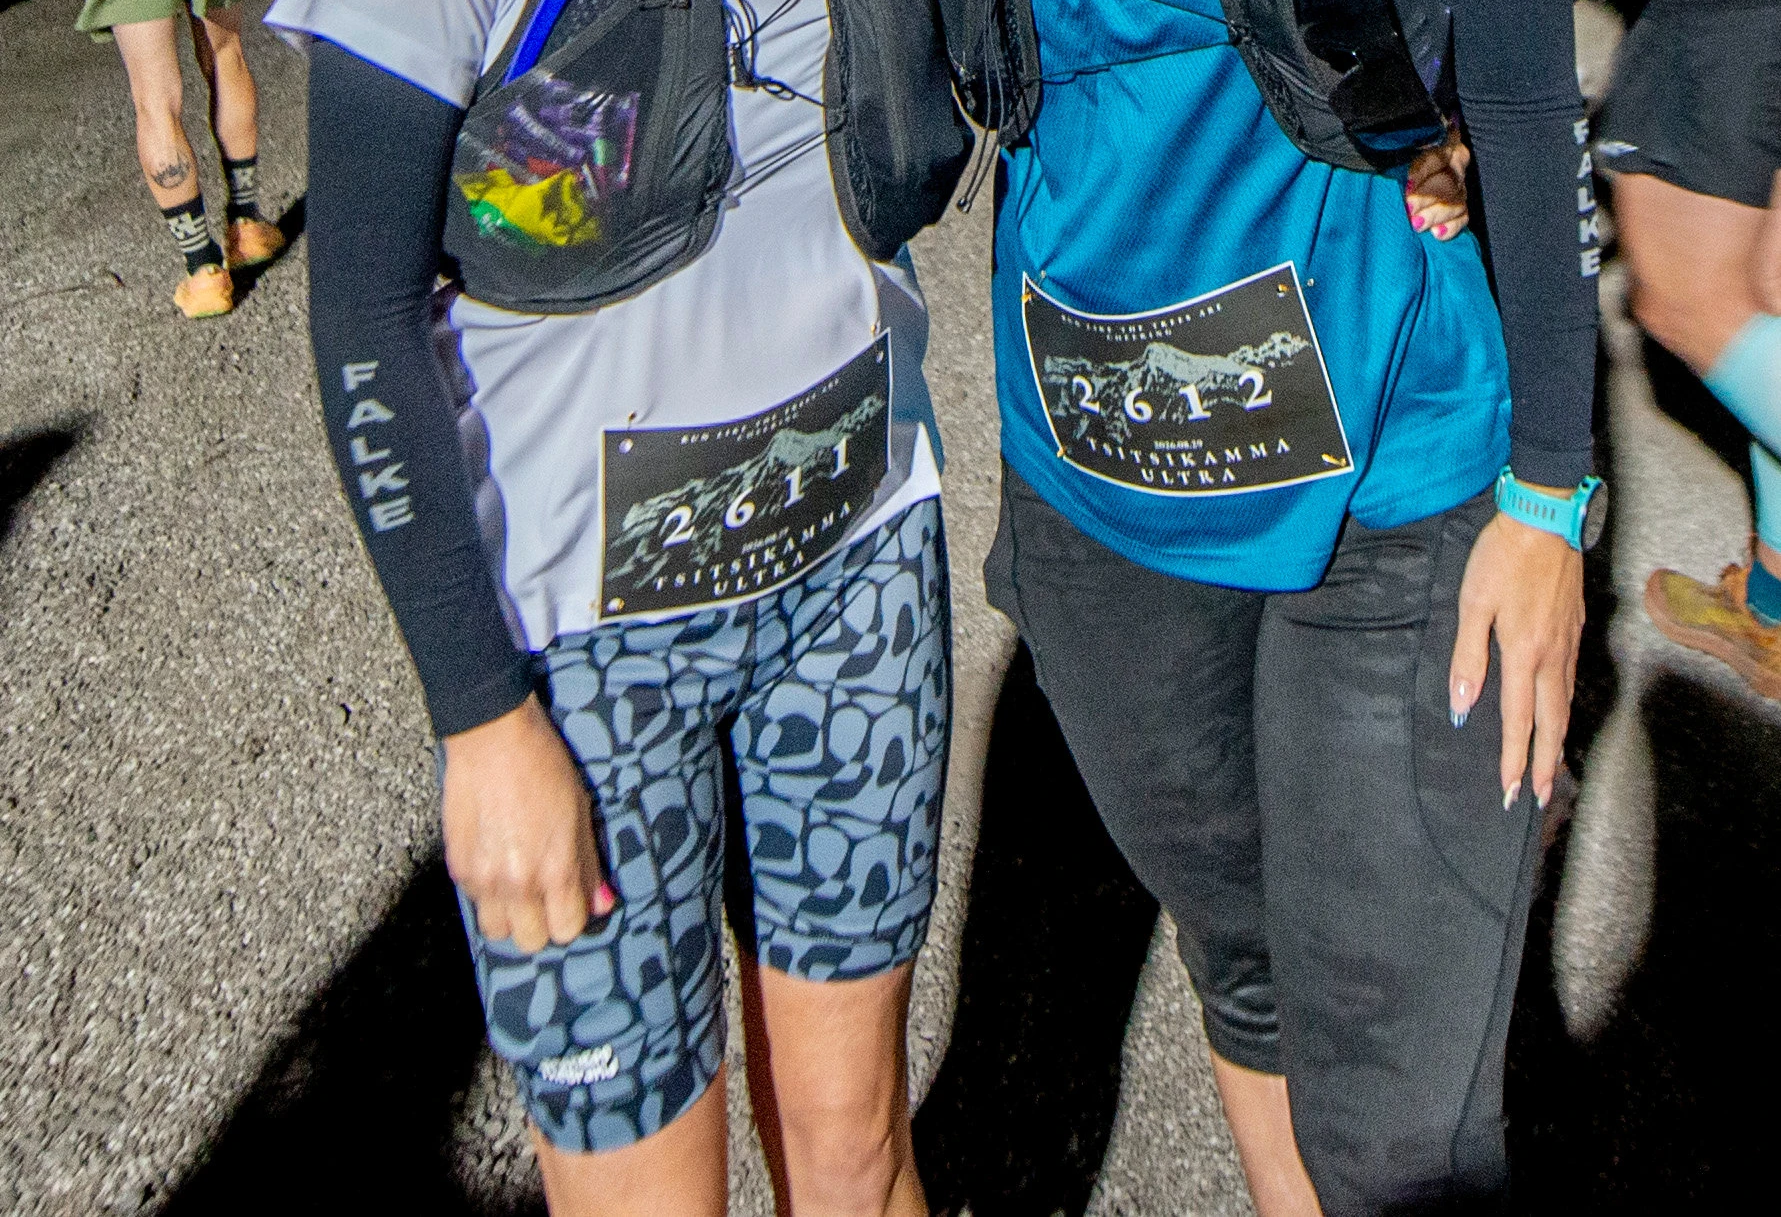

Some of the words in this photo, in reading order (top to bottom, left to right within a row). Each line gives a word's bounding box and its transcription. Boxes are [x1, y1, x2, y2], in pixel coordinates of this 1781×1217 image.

[1573, 118, 1601, 277] FALKE
[1072, 370, 1272, 423] 2612
[342, 360, 416, 532] FALKE
[1086, 437, 1290, 468] TSITSIKAMMA
[1140, 468, 1236, 486] ULTRA
[658, 437, 852, 549] 2611
[655, 501, 850, 592] TSITSIKAMMA
[714, 551, 804, 597] ULTRA
